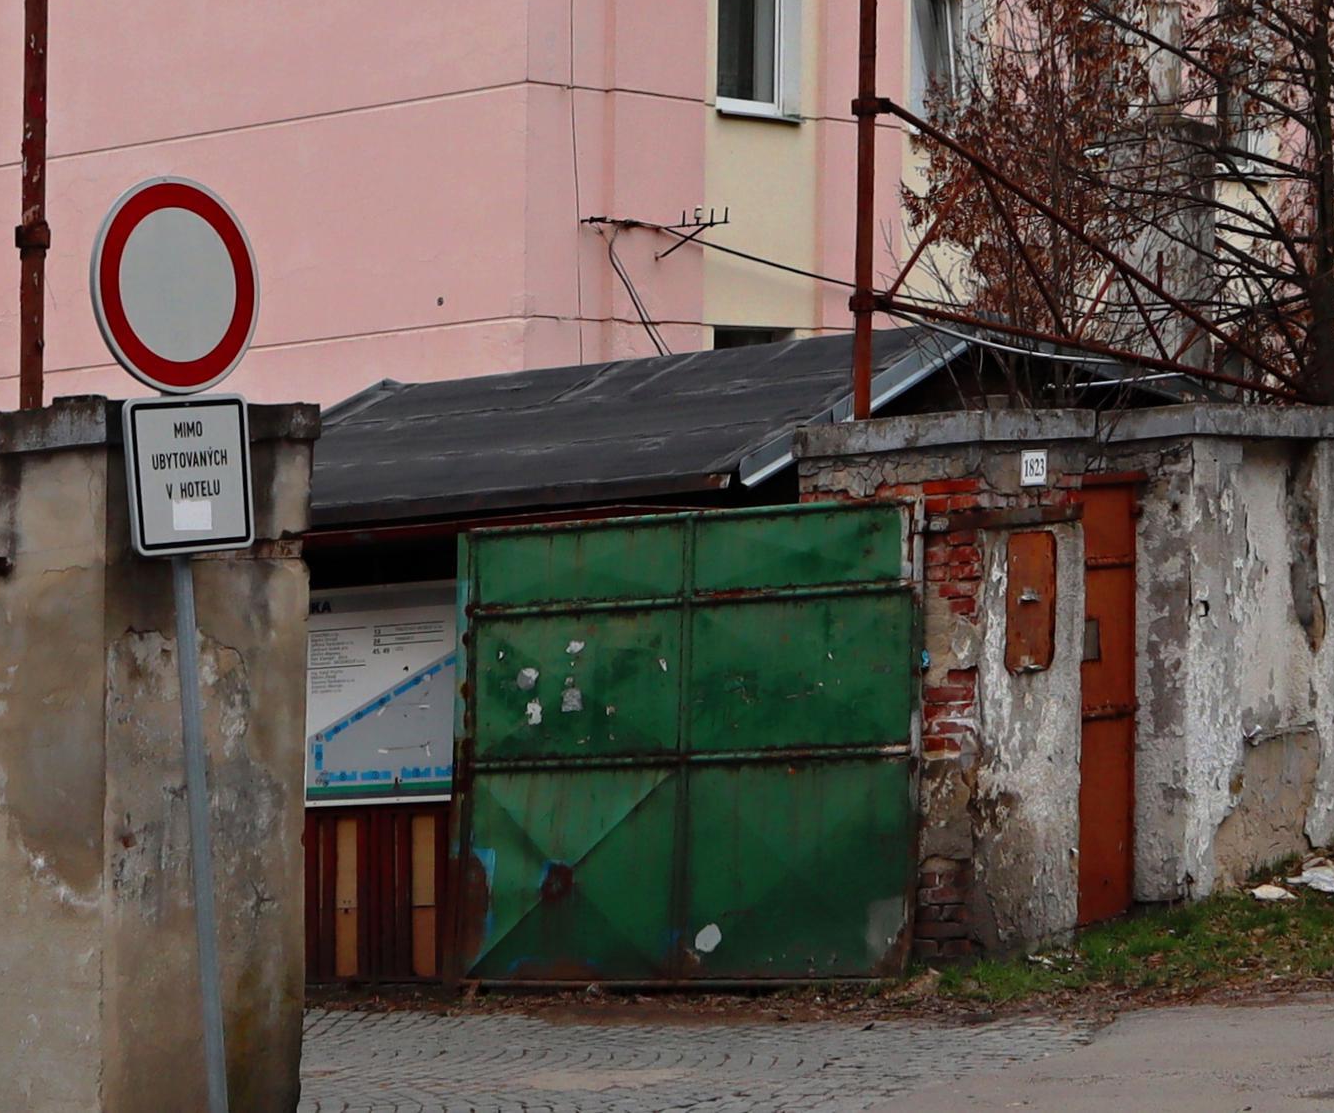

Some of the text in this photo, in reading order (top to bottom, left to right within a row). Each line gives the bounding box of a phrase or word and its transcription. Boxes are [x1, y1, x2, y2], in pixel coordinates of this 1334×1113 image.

[173, 421, 203, 438] MIMO
[151, 446, 228, 470] UBYTOVANÝCH
[1024, 458, 1044, 477] 1823
[165, 479, 220, 500] V HOTELU
